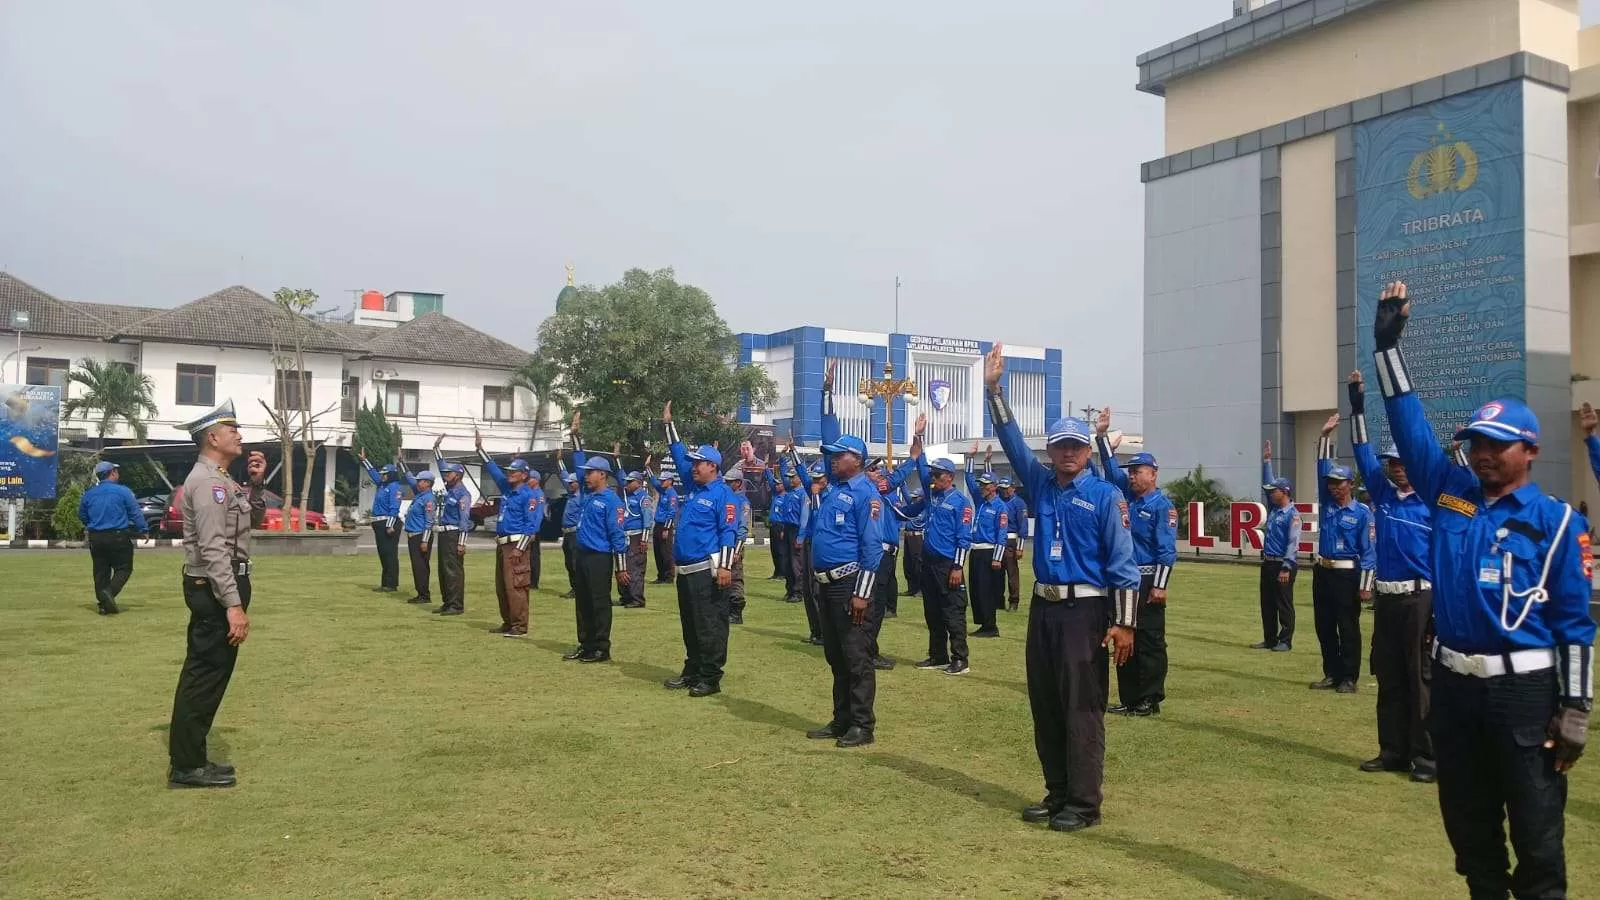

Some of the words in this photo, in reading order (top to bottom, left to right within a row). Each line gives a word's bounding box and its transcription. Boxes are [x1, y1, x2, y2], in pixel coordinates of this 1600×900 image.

[1402, 208, 1485, 235] TRIBRATA
[1419, 240, 1467, 254] INDONESIA
[1460, 258, 1484, 267] NUSA
[1454, 269, 1484, 279] PENUH
[1434, 280, 1480, 293] TERHADAP
[1485, 320, 1504, 329] DAN
[1442, 334, 1474, 344] DALAM
[1475, 341, 1514, 351] NEGARA
[1426, 357, 1470, 369] REPUBLIK
[1472, 352, 1521, 363] INDONESIA
[1418, 390, 1447, 399] DASAR
[1450, 388, 1469, 397] 1945
[1434, 422, 1453, 430] DAN
